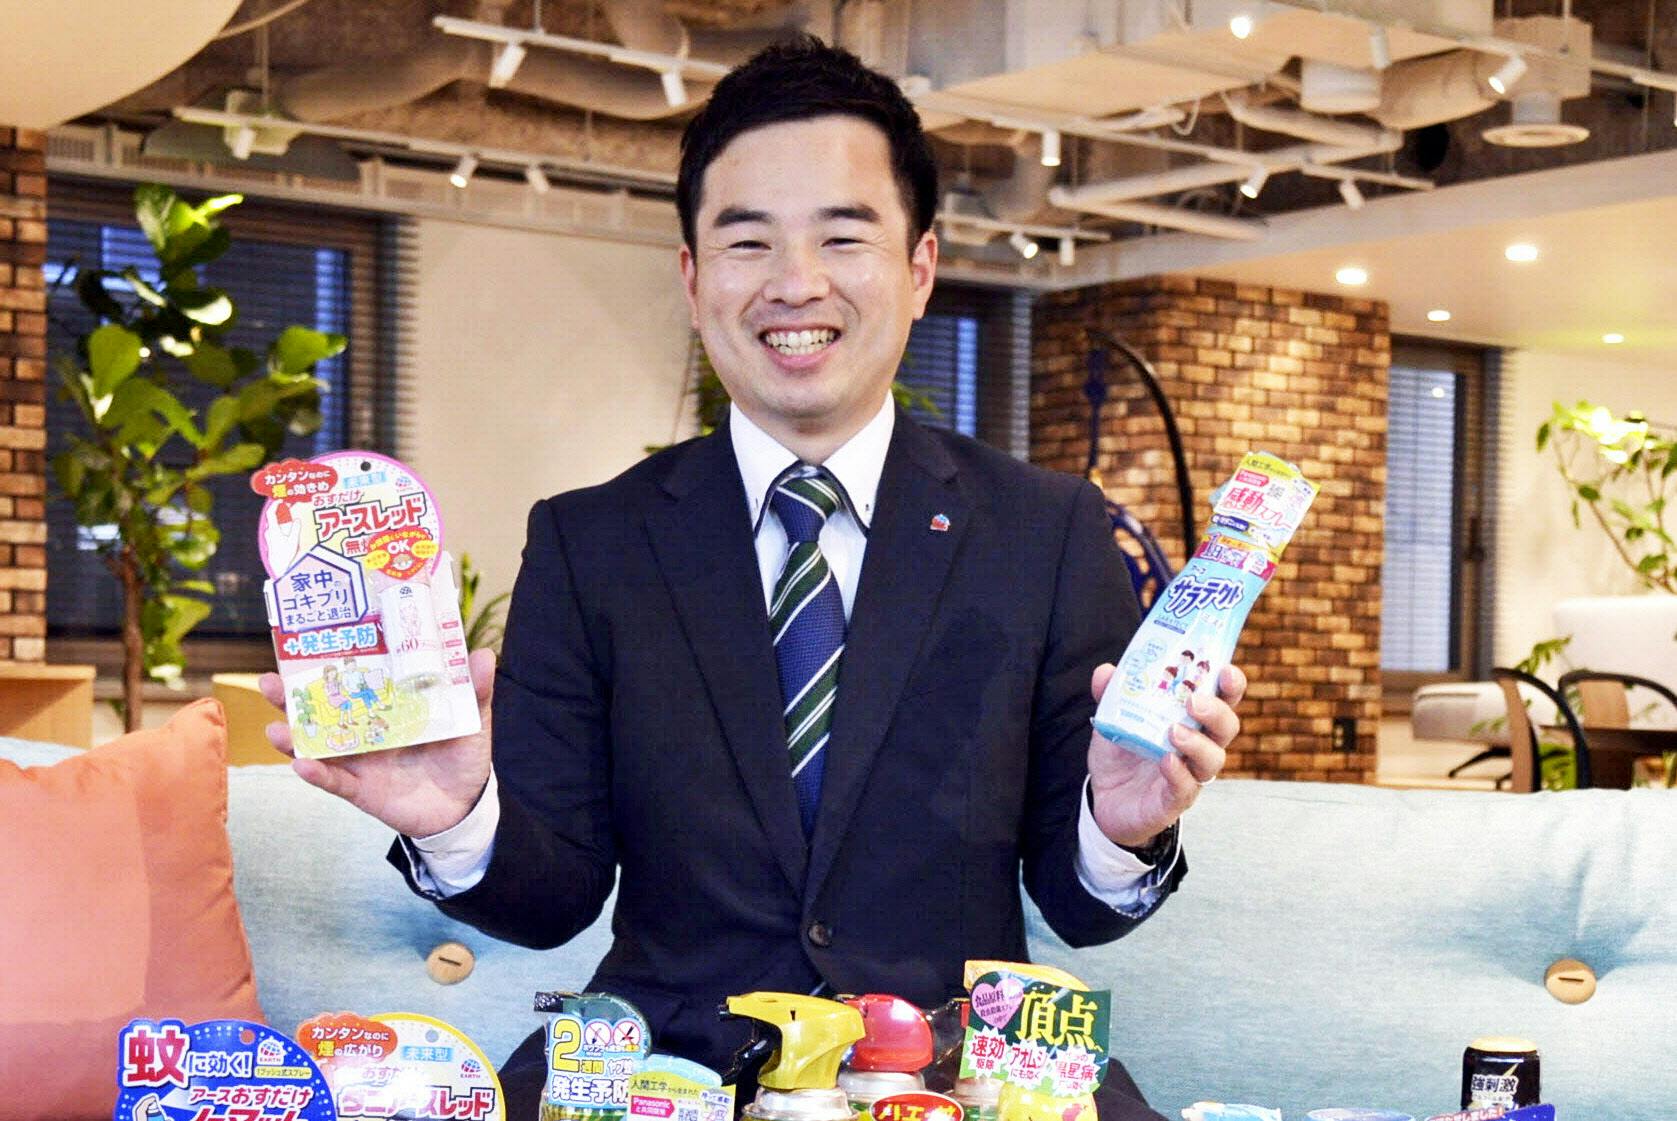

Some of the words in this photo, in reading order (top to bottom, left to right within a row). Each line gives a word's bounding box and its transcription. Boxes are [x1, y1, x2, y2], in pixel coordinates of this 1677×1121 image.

[264, 471, 331, 485] カンタンなのに
[313, 489, 362, 507] おすだけ
[318, 497, 423, 538] アースレッド
[387, 540, 410, 555] OK
[282, 589, 348, 613] ゴキブリ
[1166, 578, 1240, 615] サラテクト
[285, 606, 351, 627] まるごと退治
[1015, 990, 1105, 1052] 頂点
[311, 1026, 389, 1041] カンタンなのに
[317, 1040, 383, 1058] 煙の広がり
[404, 1046, 450, 1061] 未来型
[971, 1035, 1006, 1060] 速効
[1009, 1046, 1048, 1069] アオムシ
[1472, 1076, 1516, 1093] 強刺激
[191, 1086, 311, 1106] アースおすだけ
[343, 1088, 493, 1121] ダニスレッド
